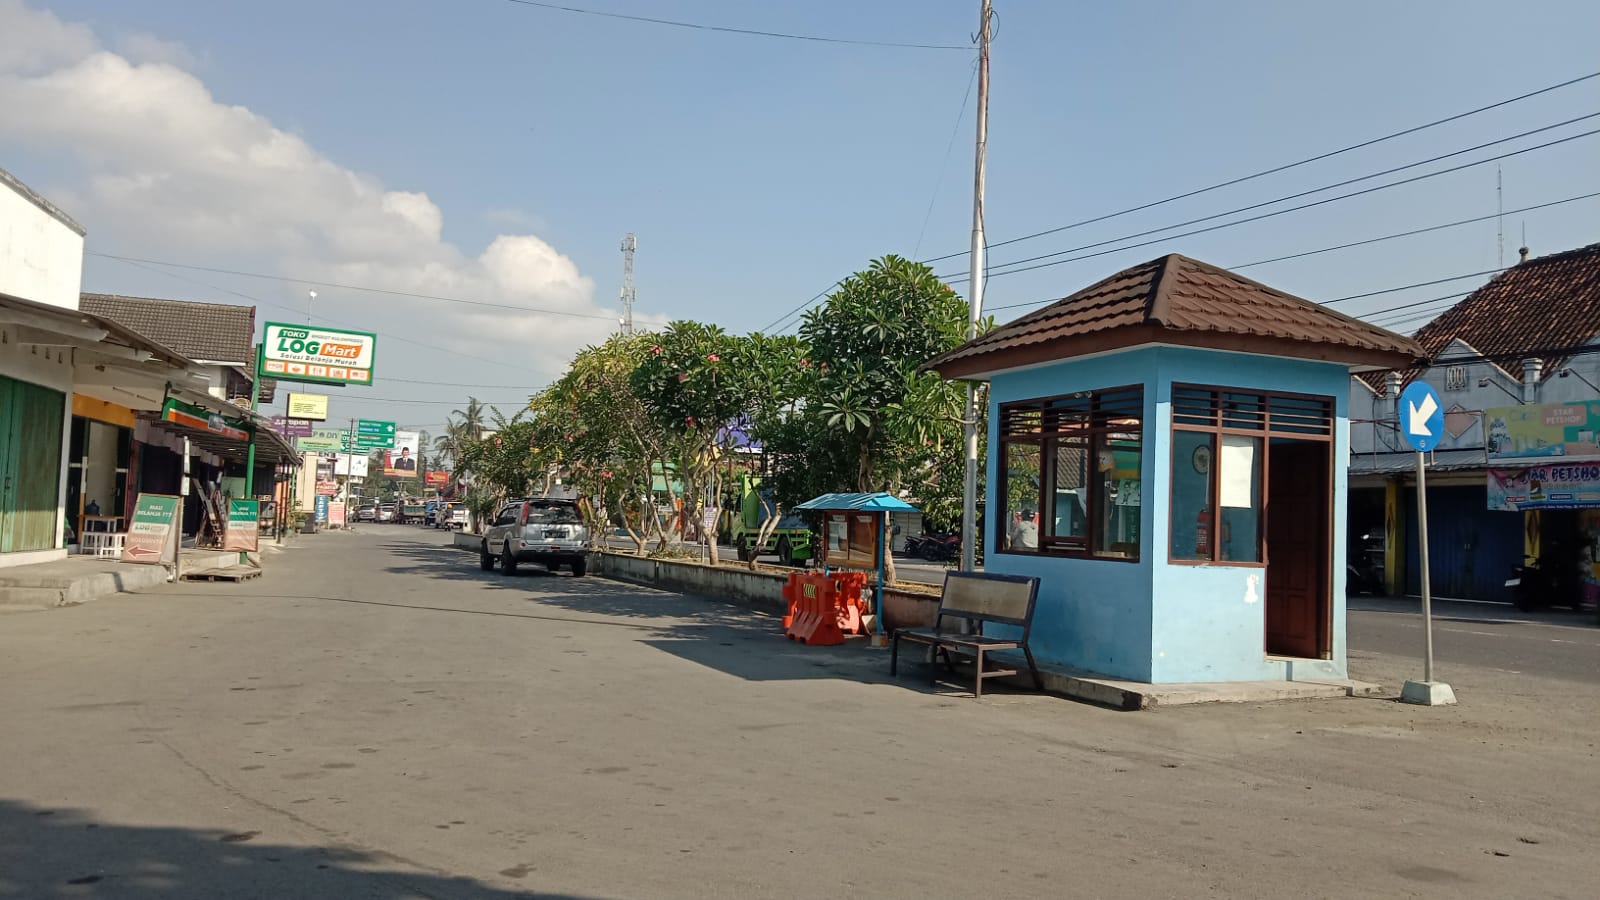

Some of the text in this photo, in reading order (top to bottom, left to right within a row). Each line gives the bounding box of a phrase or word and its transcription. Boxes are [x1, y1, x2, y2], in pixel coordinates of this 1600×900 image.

[282, 330, 306, 338] TOKO
[277, 338, 320, 355] LOG
[323, 345, 356, 357] Mart
[305, 356, 333, 364] Belanja
[1553, 408, 1574, 416] STAR
[1546, 416, 1582, 425] PETSHOP
